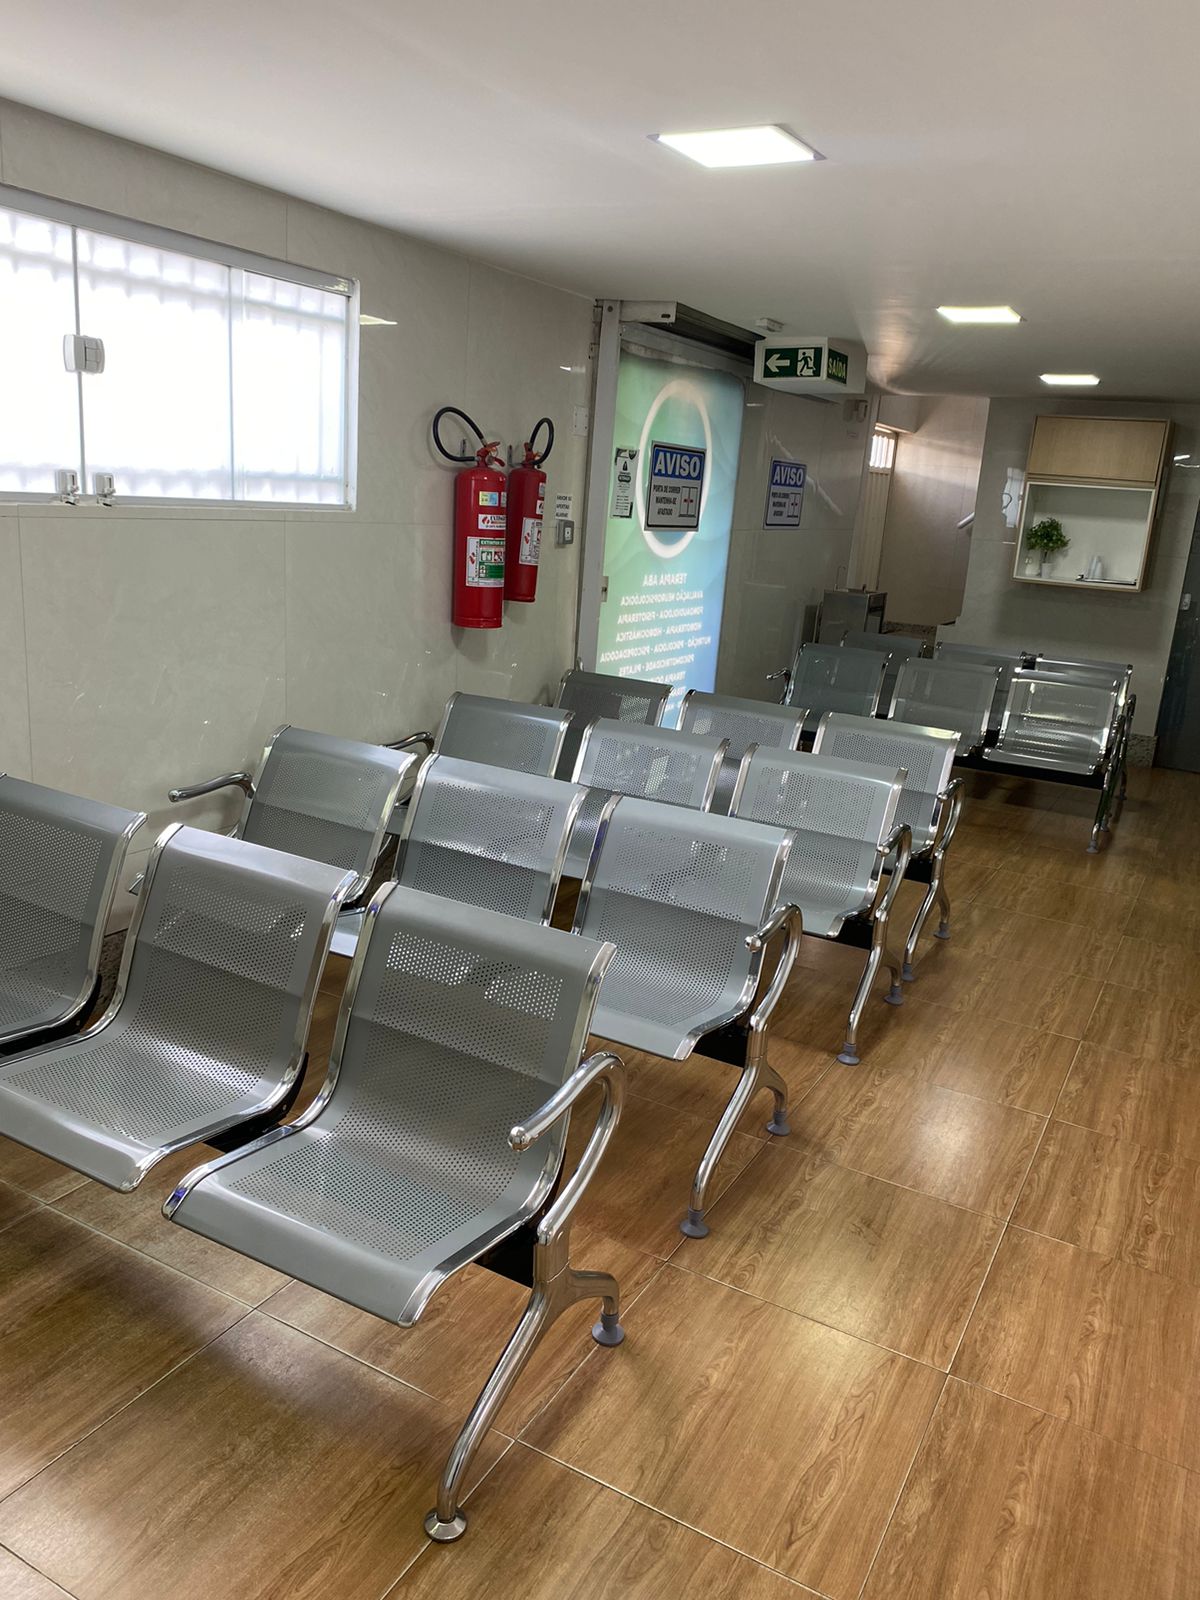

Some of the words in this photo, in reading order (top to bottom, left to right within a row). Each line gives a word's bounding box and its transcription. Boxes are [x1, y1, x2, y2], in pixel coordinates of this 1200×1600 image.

[828, 357, 846, 379] SAÍDA
[654, 451, 700, 478] AVISO
[773, 466, 804, 486] AVISO
